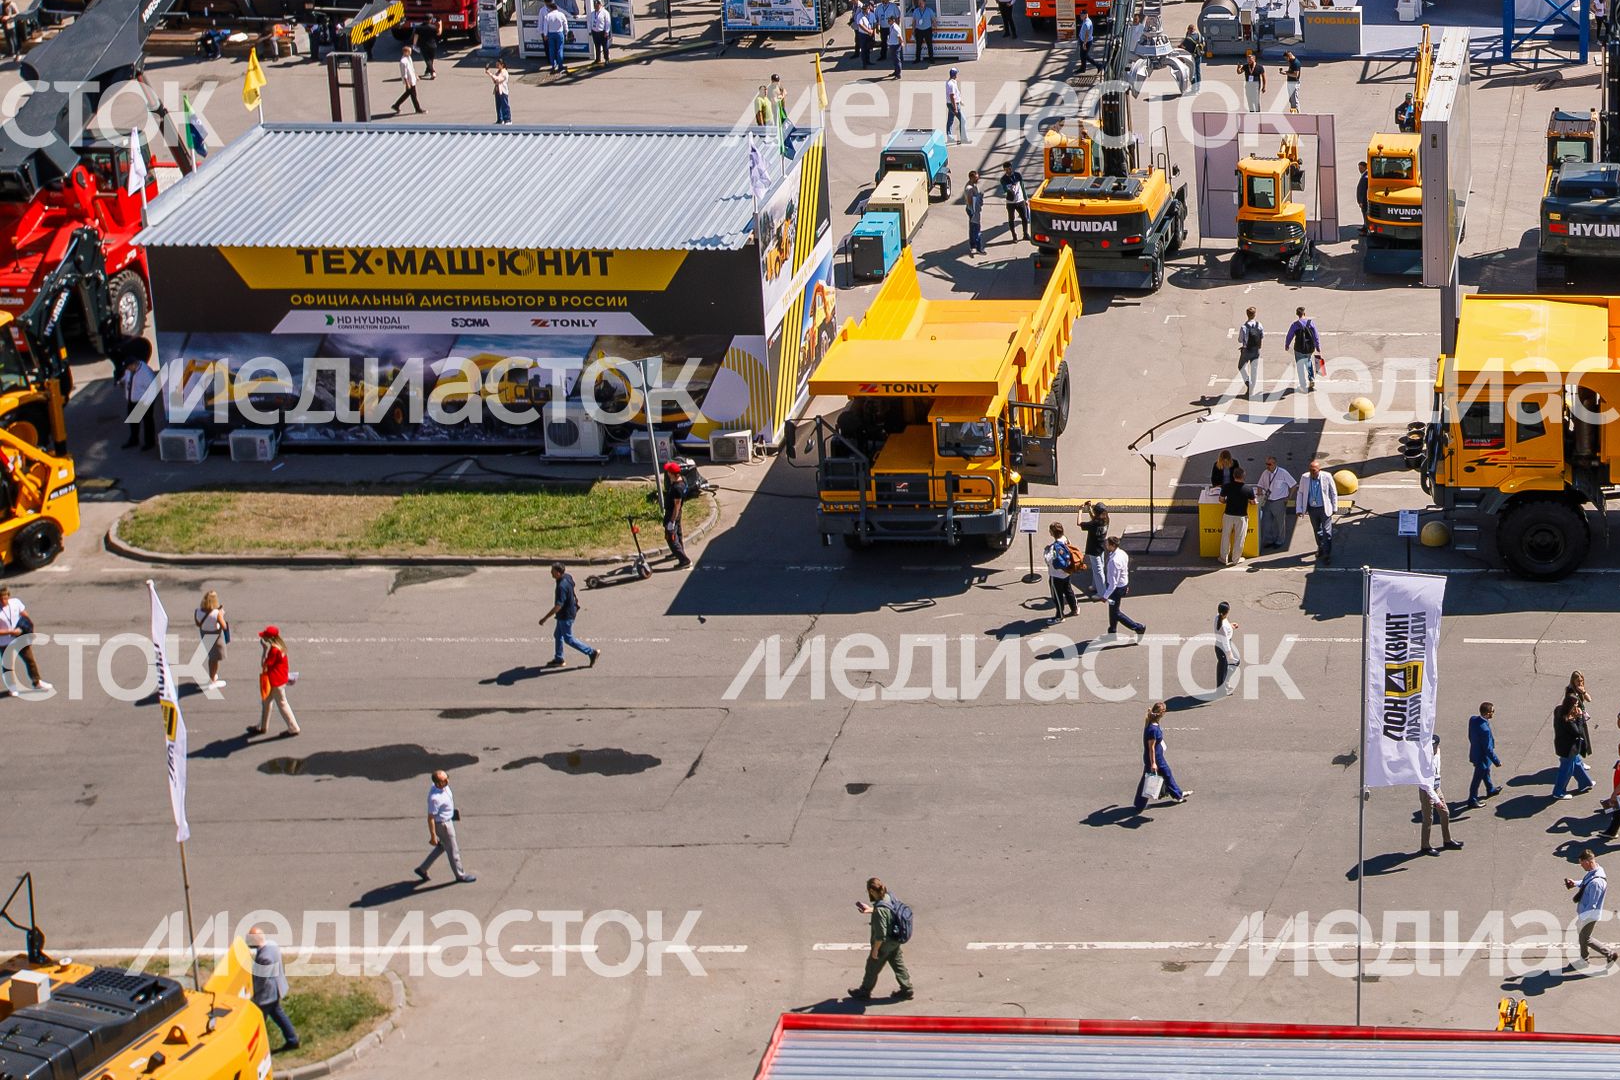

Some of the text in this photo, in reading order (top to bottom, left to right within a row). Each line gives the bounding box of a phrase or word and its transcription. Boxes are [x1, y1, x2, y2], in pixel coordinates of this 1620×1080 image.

[1387, 207, 1423, 216] HYUNDA
[1051, 219, 1118, 233] HYUNDAI
[290, 293, 629, 308] ОФИЦИАЛЬНЫЙ ДИСТРИБЬЮТОР В РОССИИ
[336, 315, 401, 325] HD HYUNDAI
[550, 319, 598, 328] TONLY
[881, 383, 939, 395] TONLY
[1383, 613, 1410, 741] ЛОН КВИНТ
[1406, 611, 1427, 741] МАДИ МАДИ
